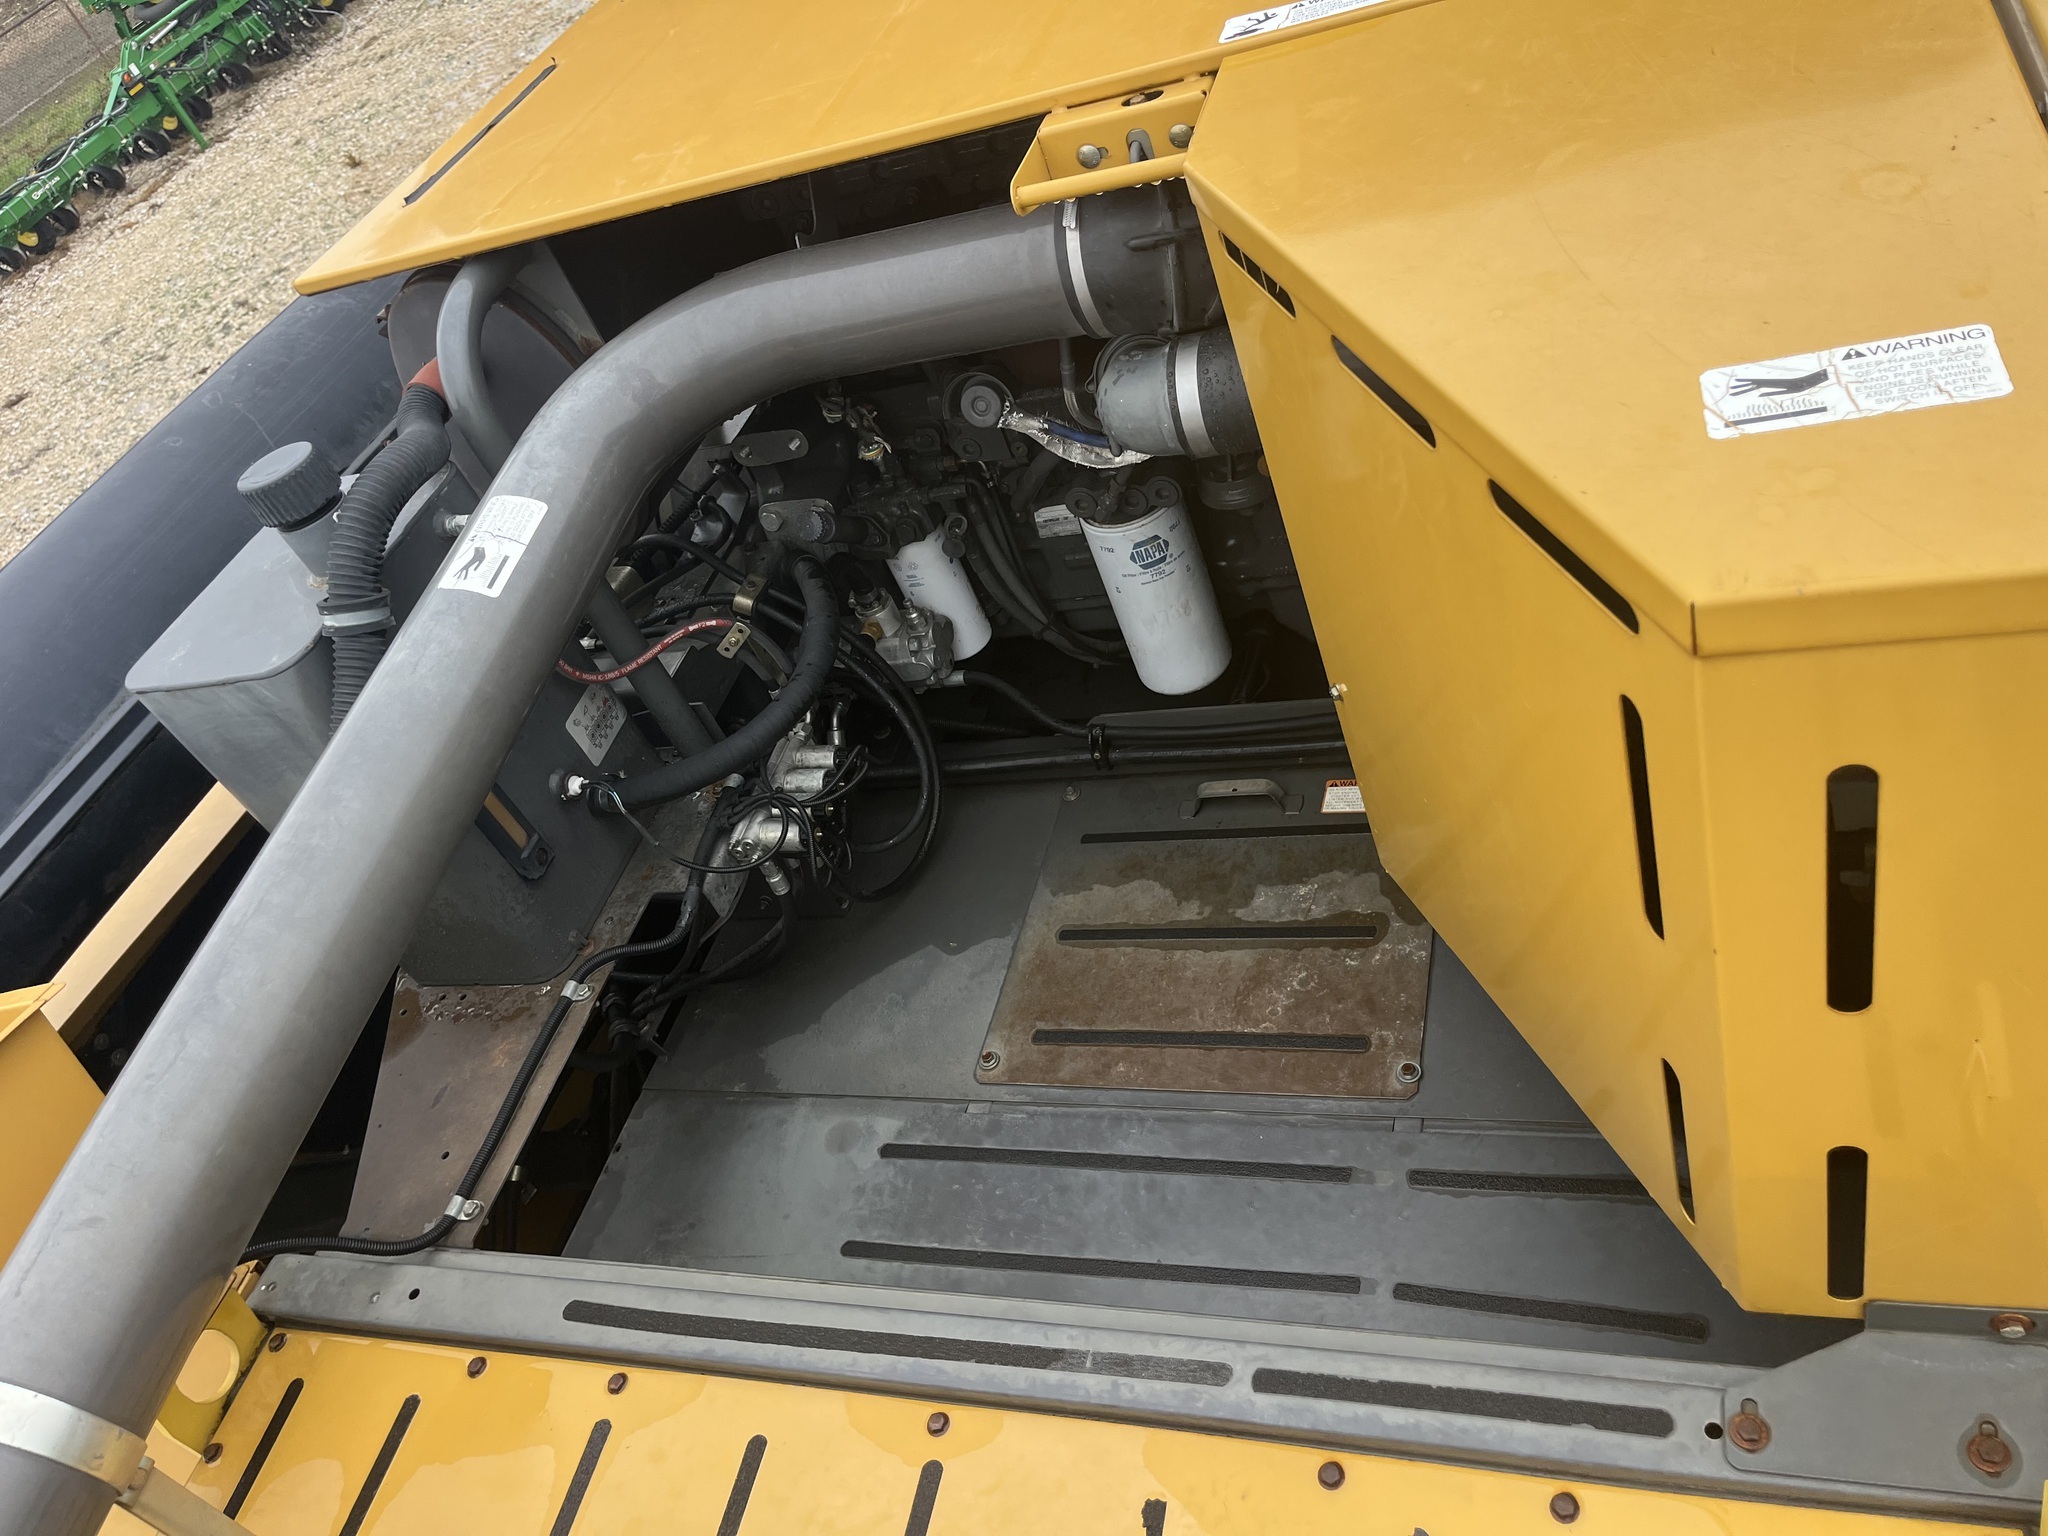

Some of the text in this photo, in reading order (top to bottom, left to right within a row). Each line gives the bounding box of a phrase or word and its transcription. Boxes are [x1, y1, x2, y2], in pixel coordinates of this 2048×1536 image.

[1867, 328, 1986, 356] WARNING
[1848, 343, 1984, 371] KEEP HANDS CLEAR
[1878, 364, 1904, 375] HOT
[1909, 352, 1982, 369] SURFACES
[1855, 379, 1909, 393] ENGINE
[1931, 366, 1992, 383] RUNNING
[1862, 360, 1981, 384] AND PIPES WHILE
[1864, 389, 1893, 400] AND
[1944, 374, 1988, 386] AFTER
[1874, 391, 1930, 405] SWITCH
[1135, 540, 1166, 563] NAPA
[1150, 569, 1166, 579] 7792
[621, 663, 639, 674] FLAME
[637, 644, 663, 665] RESISTANT
